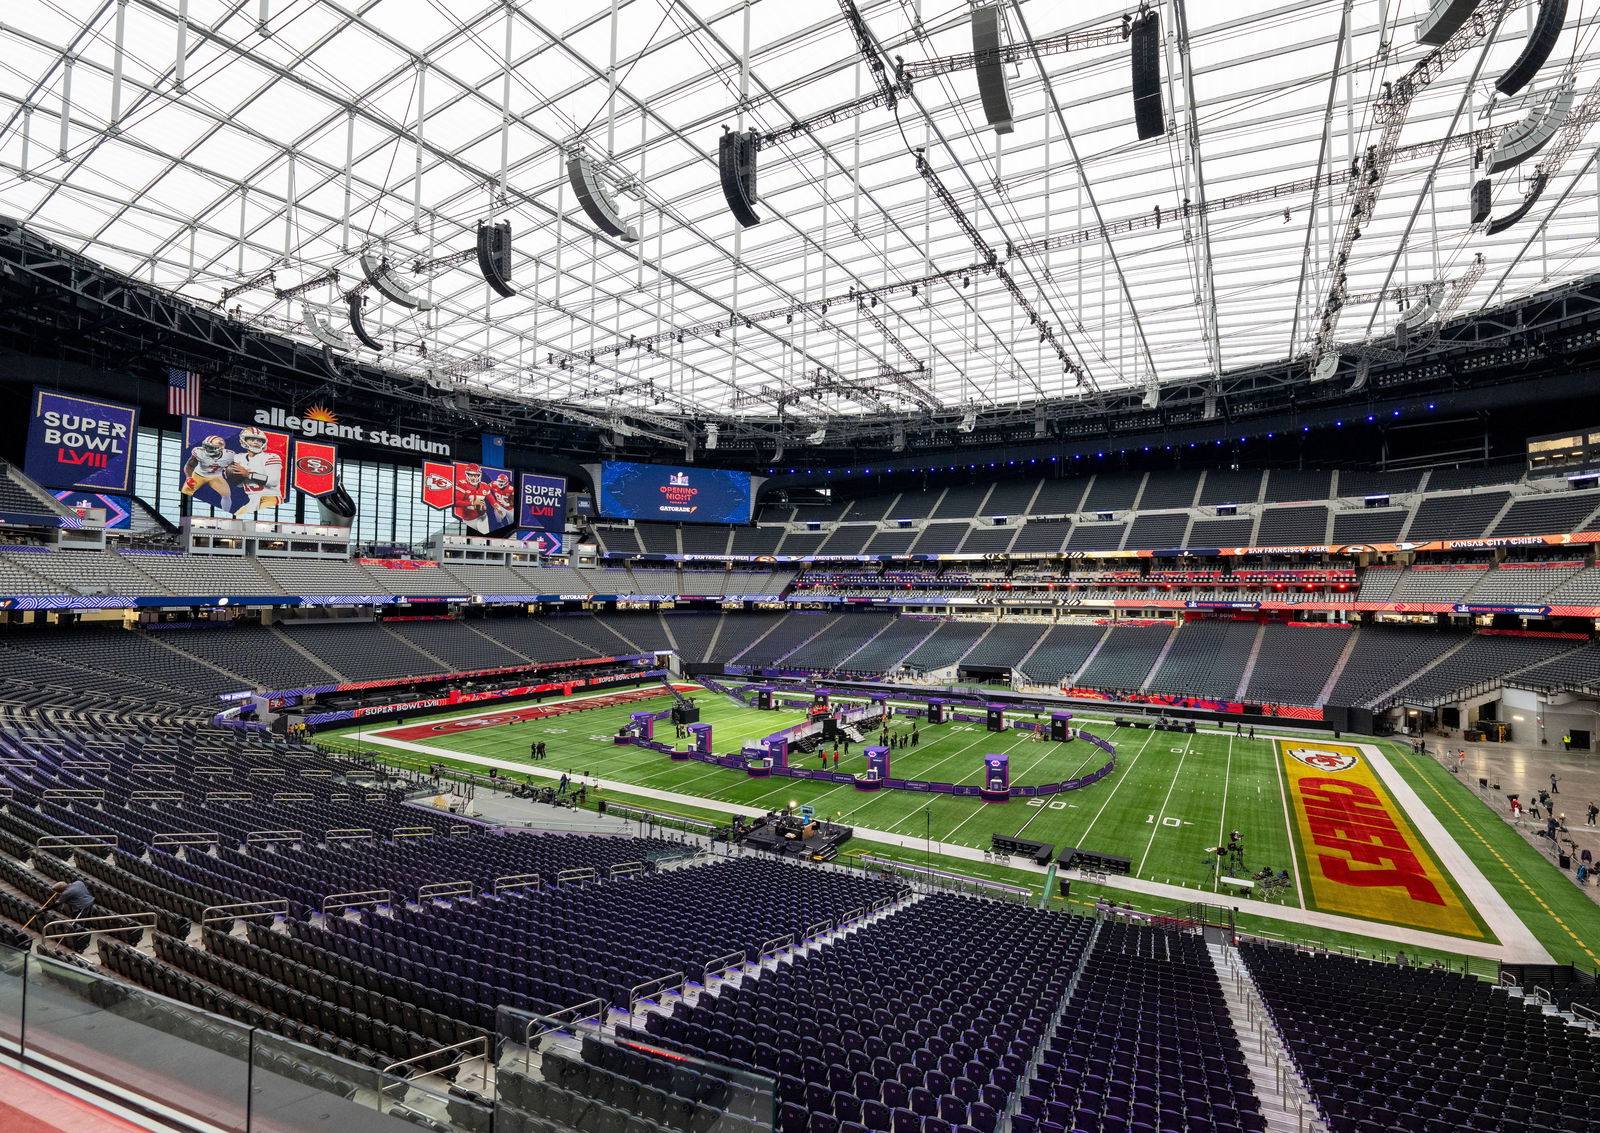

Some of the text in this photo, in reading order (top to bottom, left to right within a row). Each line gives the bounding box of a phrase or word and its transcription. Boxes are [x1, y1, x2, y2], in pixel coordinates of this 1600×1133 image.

[43, 411, 127, 438] SUPER
[254, 407, 450, 456] allegiant stadium
[44, 428, 123, 454] BOWL
[57, 448, 107, 468] LVIII
[524, 484, 562, 497] SUPER
[660, 486, 698, 495] OPENING
[666, 493, 692, 501] NIGHT
[525, 494, 561, 507] BOWL
[531, 506, 554, 516] LVIII
[1449, 540, 1484, 548] KANSAS
[1511, 537, 1543, 545] CHIEFS
[365, 700, 439, 716] SUPER BOWL LVIII
[1026, 798, 1067, 810] 20
[1145, 814, 1181, 827] 10
[1297, 776, 1448, 906] CHIEFS
